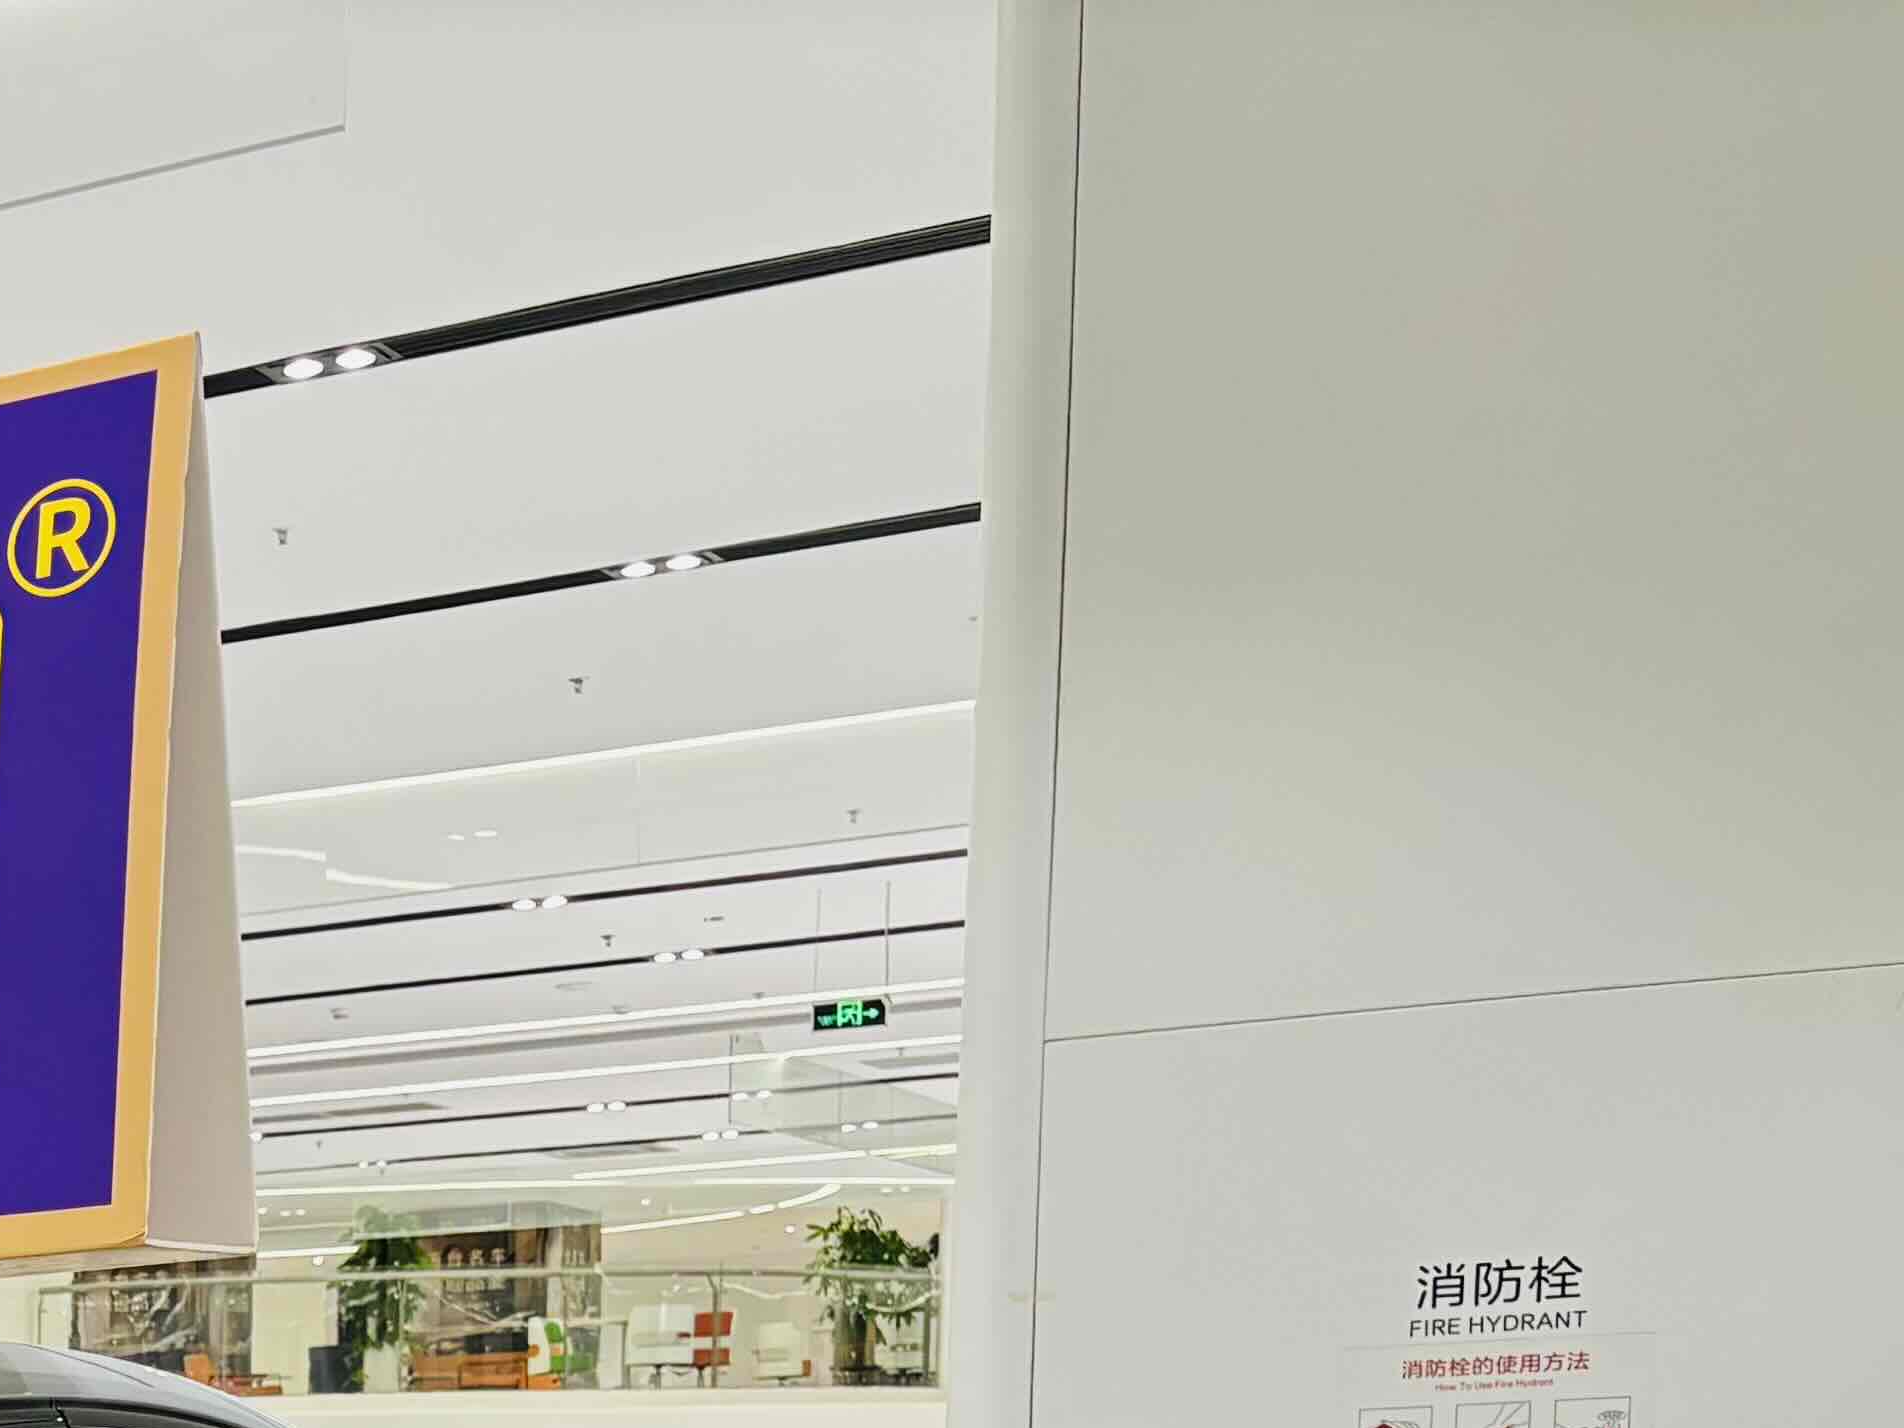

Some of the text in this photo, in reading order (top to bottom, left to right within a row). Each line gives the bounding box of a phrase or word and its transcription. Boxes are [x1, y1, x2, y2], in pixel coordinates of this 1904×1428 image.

[1416, 1255, 1584, 1310] 消防栓
[1408, 1310, 1588, 1338] FIRE HYDRANT
[1401, 1349, 1591, 1379] 消防栓的使用方法
